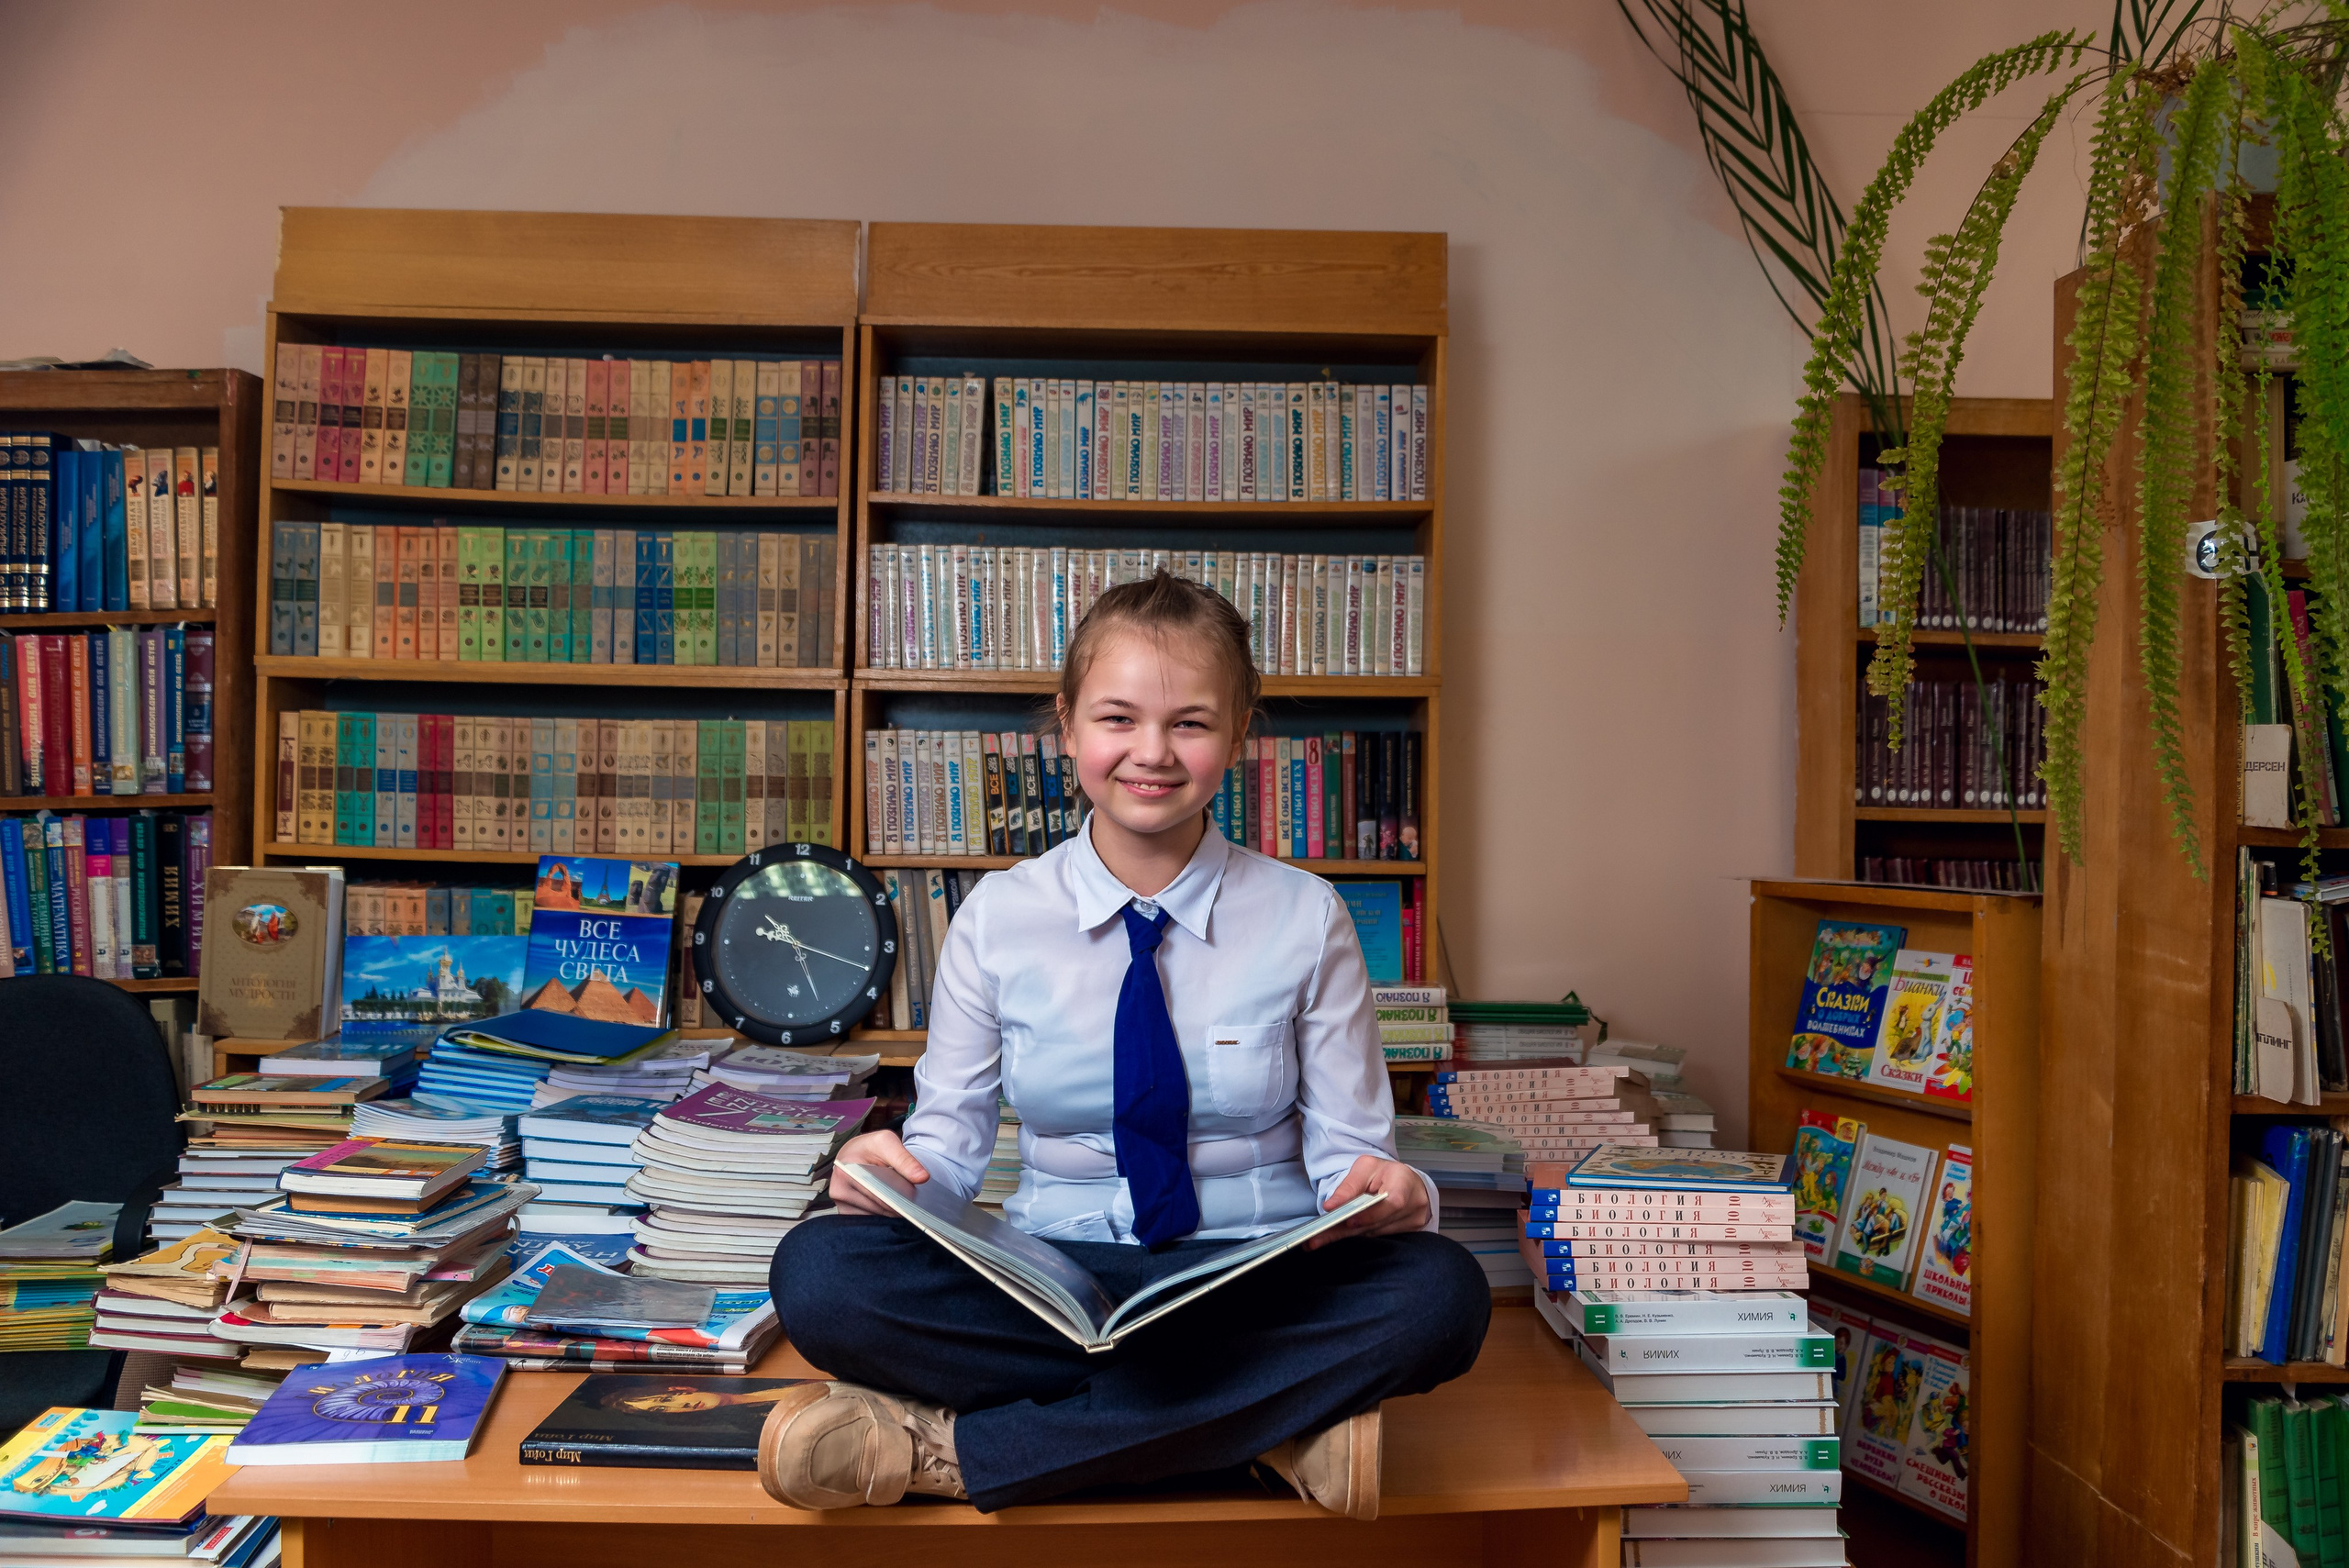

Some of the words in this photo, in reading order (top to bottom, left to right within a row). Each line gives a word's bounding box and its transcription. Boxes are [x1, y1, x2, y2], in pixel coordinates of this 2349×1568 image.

[930, 404, 941, 430] МИР
[1032, 406, 1043, 430] МИР
[1242, 406, 1253, 432] МИР
[1415, 409, 1425, 433] МИР
[927, 433, 940, 481] ПОЗНАЮ
[1033, 432, 1043, 476] ПОЗНАЮ
[1242, 435, 1253, 484] ПОЗНАЮ
[925, 484, 938, 493] Я
[1032, 479, 1043, 488] Я
[1241, 485, 1253, 495] Я
[1413, 486, 1424, 495] Я
[1315, 586, 1326, 607] МИР
[1349, 584, 1359, 608] МИР
[1347, 657, 1356, 665] Я
[987, 734, 996, 752] 1
[1004, 734, 1017, 757] 2
[1025, 734, 1032, 751] 3
[1280, 740, 1288, 760] 6
[1308, 740, 1319, 765] 8
[885, 757, 896, 782] МИР
[902, 761, 913, 784] МИР
[965, 757, 978, 783] МИР
[2244, 761, 2286, 772] ДЕРСЕН
[990, 773, 999, 795] ВСЕ
[1027, 775, 1036, 795] ВСЕ
[1063, 776, 1072, 796] ВСЕ
[1281, 765, 1289, 793] ВСЕХ
[1294, 764, 1302, 791] ВСЕХ
[885, 784, 897, 831] ПОЗНАЮ
[903, 786, 914, 831] ПОЗНАЮ
[1281, 795, 1289, 817] ОБО
[886, 833, 897, 843] Я
[903, 833, 915, 842] Я
[969, 837, 981, 846] Я
[749, 853, 762, 865] 11
[795, 844, 812, 856] 12
[845, 859, 852, 871] 1
[164, 866, 180, 929] ХИМИЯ
[710, 886, 723, 898] 10
[875, 893, 886, 906] 2
[51, 882, 68, 960] МАТЕМАТИКА
[579, 919, 622, 940] ВСЕ
[905, 919, 914, 934] Кто
[695, 932, 705, 945] 9
[884, 940, 895, 953] 3
[555, 939, 640, 962] ЧУДЕСА
[559, 962, 629, 984] СВЕТА
[703, 981, 714, 993] 8
[1893, 972, 1946, 996] Бианки
[866, 987, 877, 1000] 4
[1376, 993, 1419, 1003] ПОЗНАЮ
[1422, 993, 1430, 1003] Я
[735, 1018, 744, 1029] 7
[914, 1007, 923, 1028] Том
[1428, 1009, 1437, 1022] Я
[829, 1021, 841, 1033] 5
[1807, 1020, 1865, 1038] ВОЛШЕБНИКАХ
[781, 1031, 792, 1044] 6
[2257, 1033, 2292, 1050] ПЛИНГ
[1470, 1070, 1561, 1081] БИОЛОГИЯ
[1881, 1064, 1923, 1084] Сказки
[1459, 1080, 1547, 1094] БИОЛОГИЯ
[707, 1097, 846, 1121] ENGLISH
[717, 1092, 818, 1113] ENJOY
[677, 1114, 744, 1131] Student's
[1578, 1194, 1702, 1206] БИОЛОГИЯ
[1575, 1209, 1700, 1221] БИОЛОГИЯ
[1572, 1226, 1698, 1238] БИОЛОГИЯ
[1595, 1277, 1718, 1289] БИОЛОГИЯ
[1923, 1269, 1971, 1294] ШКОЛЬНЫ
[1737, 1312, 1774, 1321] ХИМИЯ
[1643, 1350, 1680, 1359] ХИМИЯ
[295, 1369, 457, 1399] БИОЛОГИЯ
[385, 1405, 440, 1424] 11
[524, 1450, 553, 1462] Гойи
[556, 1448, 582, 1462] Мир
[1906, 1458, 1956, 1486] СМЕШНЫЕ
[1770, 1484, 1806, 1493] ХИМИЯ
[1938, 1494, 1966, 1514] ШКОЛ
